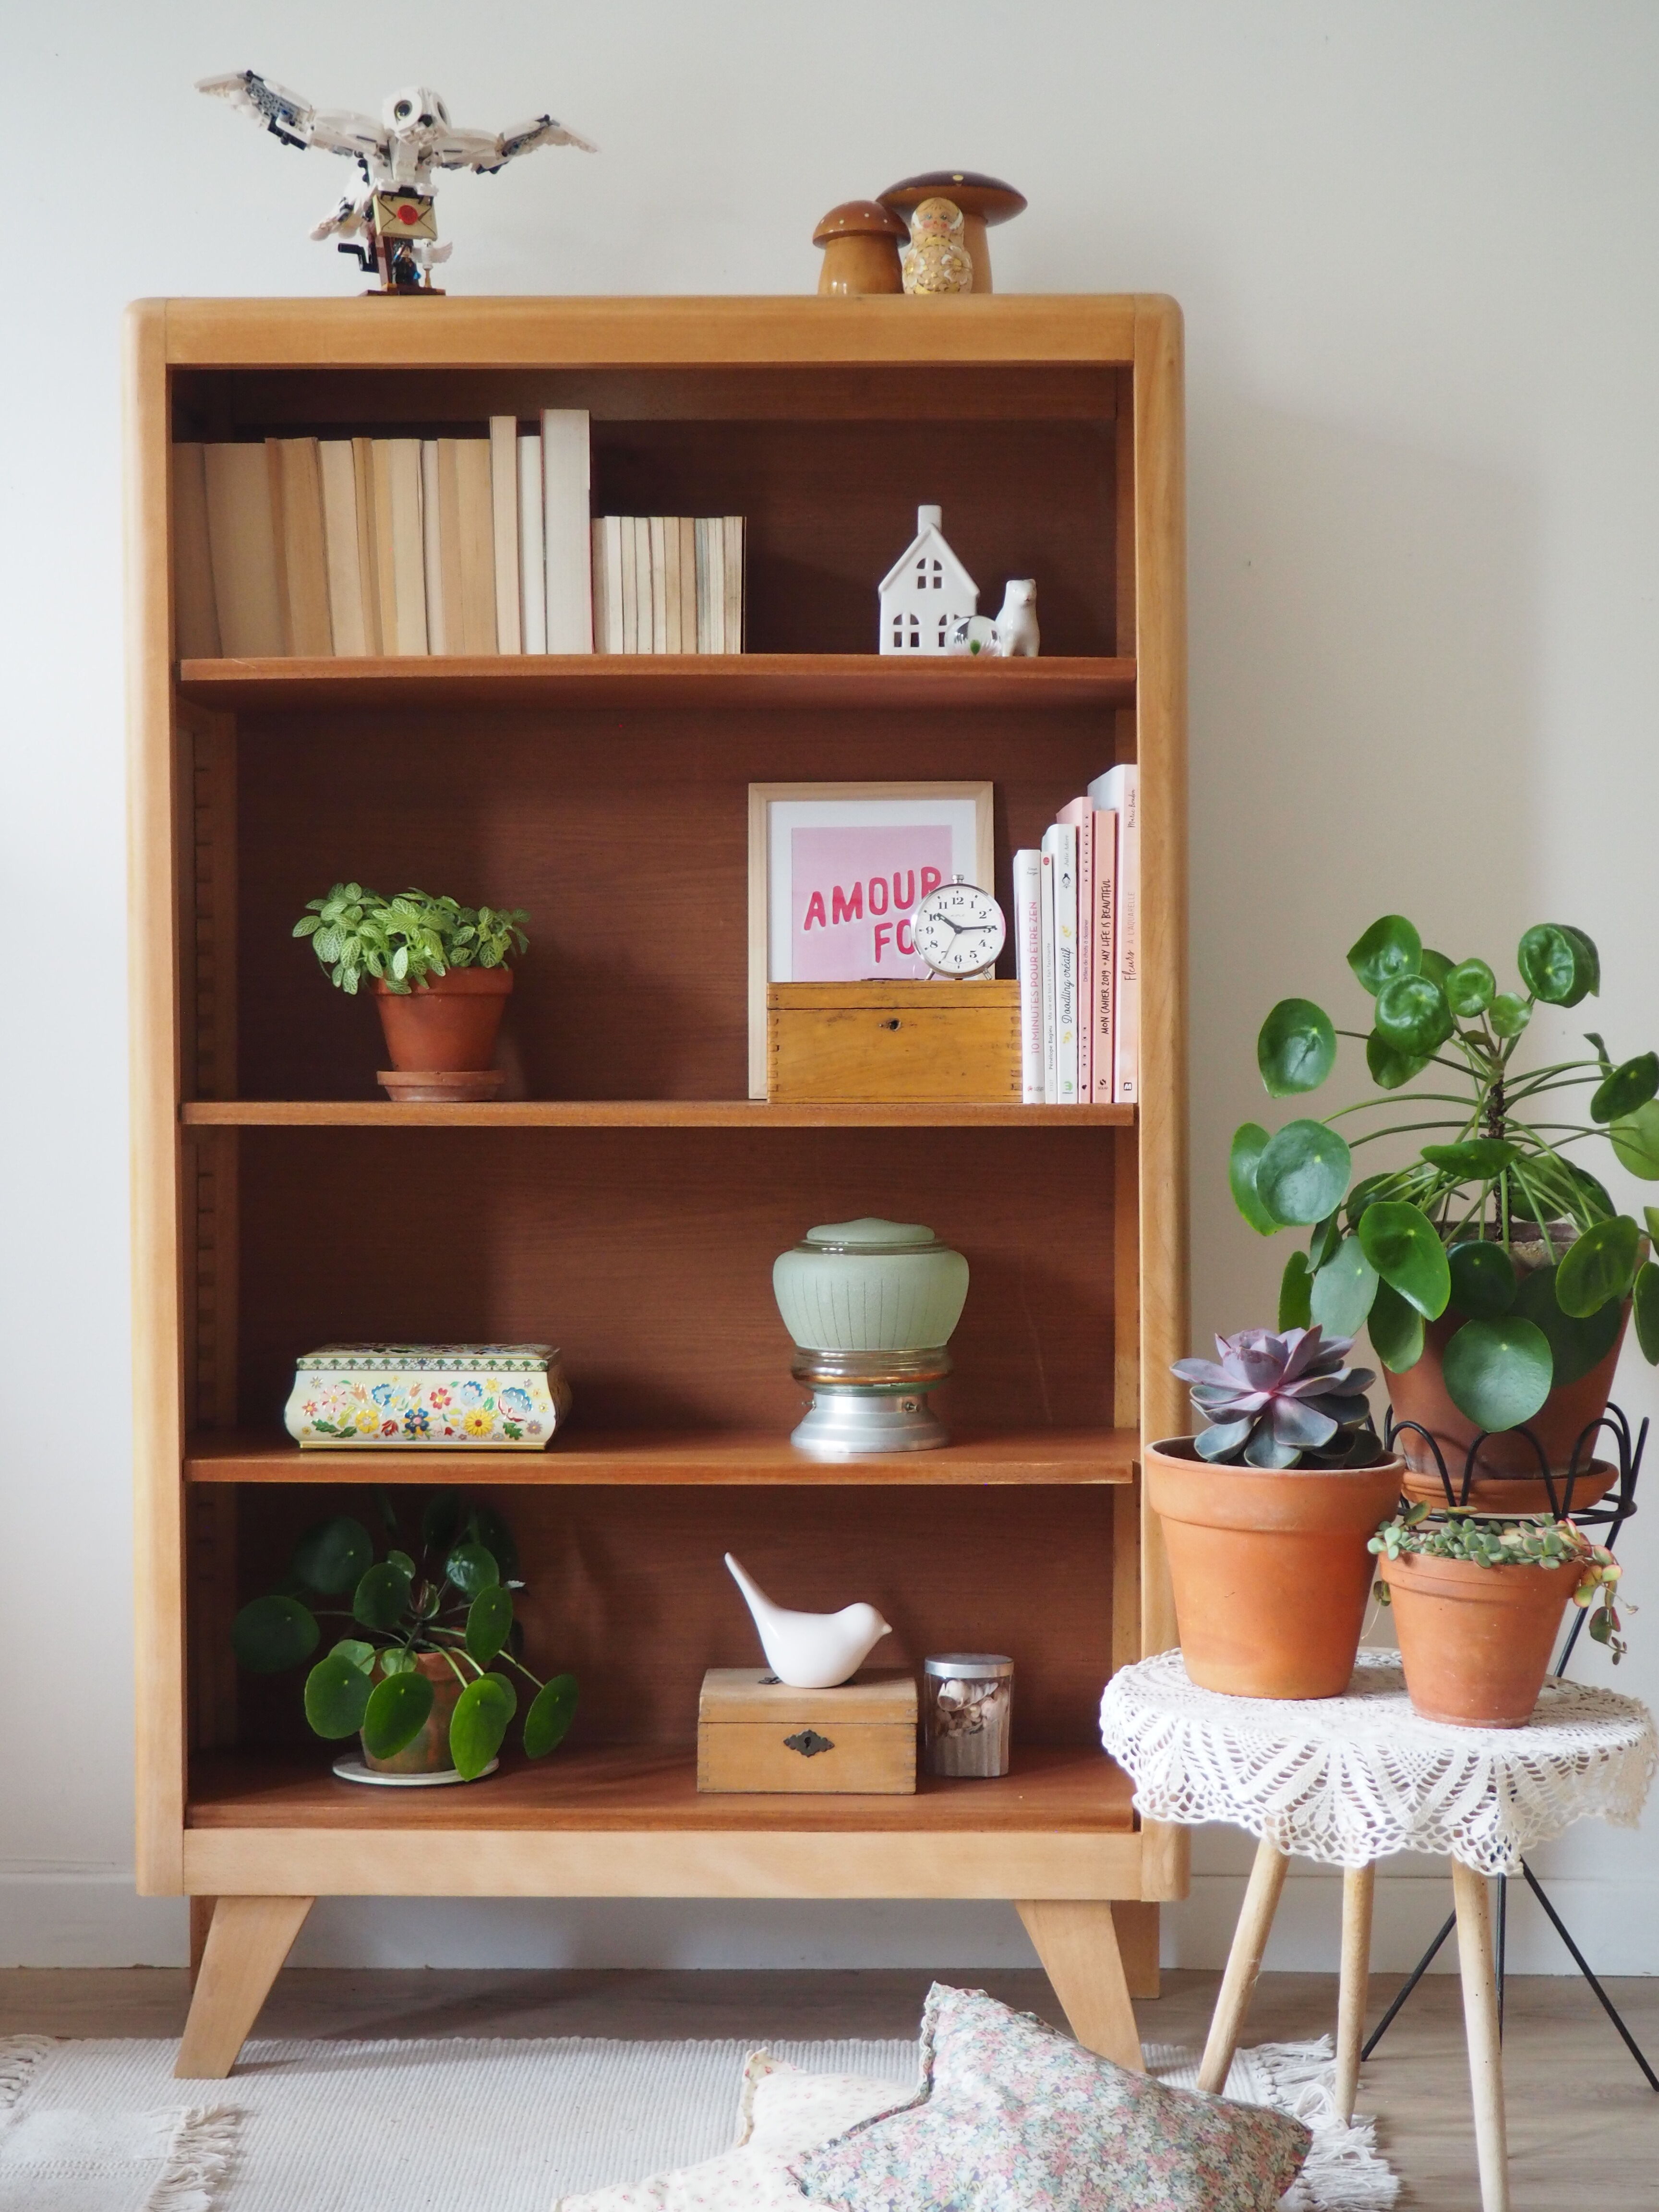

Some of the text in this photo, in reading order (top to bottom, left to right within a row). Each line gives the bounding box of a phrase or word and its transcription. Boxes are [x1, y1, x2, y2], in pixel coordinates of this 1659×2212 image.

[1127, 808, 1136, 828] Marie
[804, 866, 941, 930] AMOUR
[952, 897, 964, 905] 12
[1101, 879, 1112, 919] BEAUTIFUL
[979, 911, 987, 919] 2
[1127, 892, 1135, 935] L'AQUARELLE
[930, 940, 938, 948] 8
[1101, 931, 1111, 946] LIFE
[954, 954, 962, 963] 6
[1101, 950, 1110, 961] MY
[1121, 950, 1137, 981] Fleurs
[1027, 902, 1039, 1054] 10 MINUTES POUR ÊTRE ZEN
[1060, 947, 1074, 1023] Doodling créatif
[1101, 970, 1111, 986] 2019
[1100, 988, 1110, 1014] CAHIER
[1048, 1012, 1052, 1020] Ma
[1101, 1017, 1109, 1034] MON
